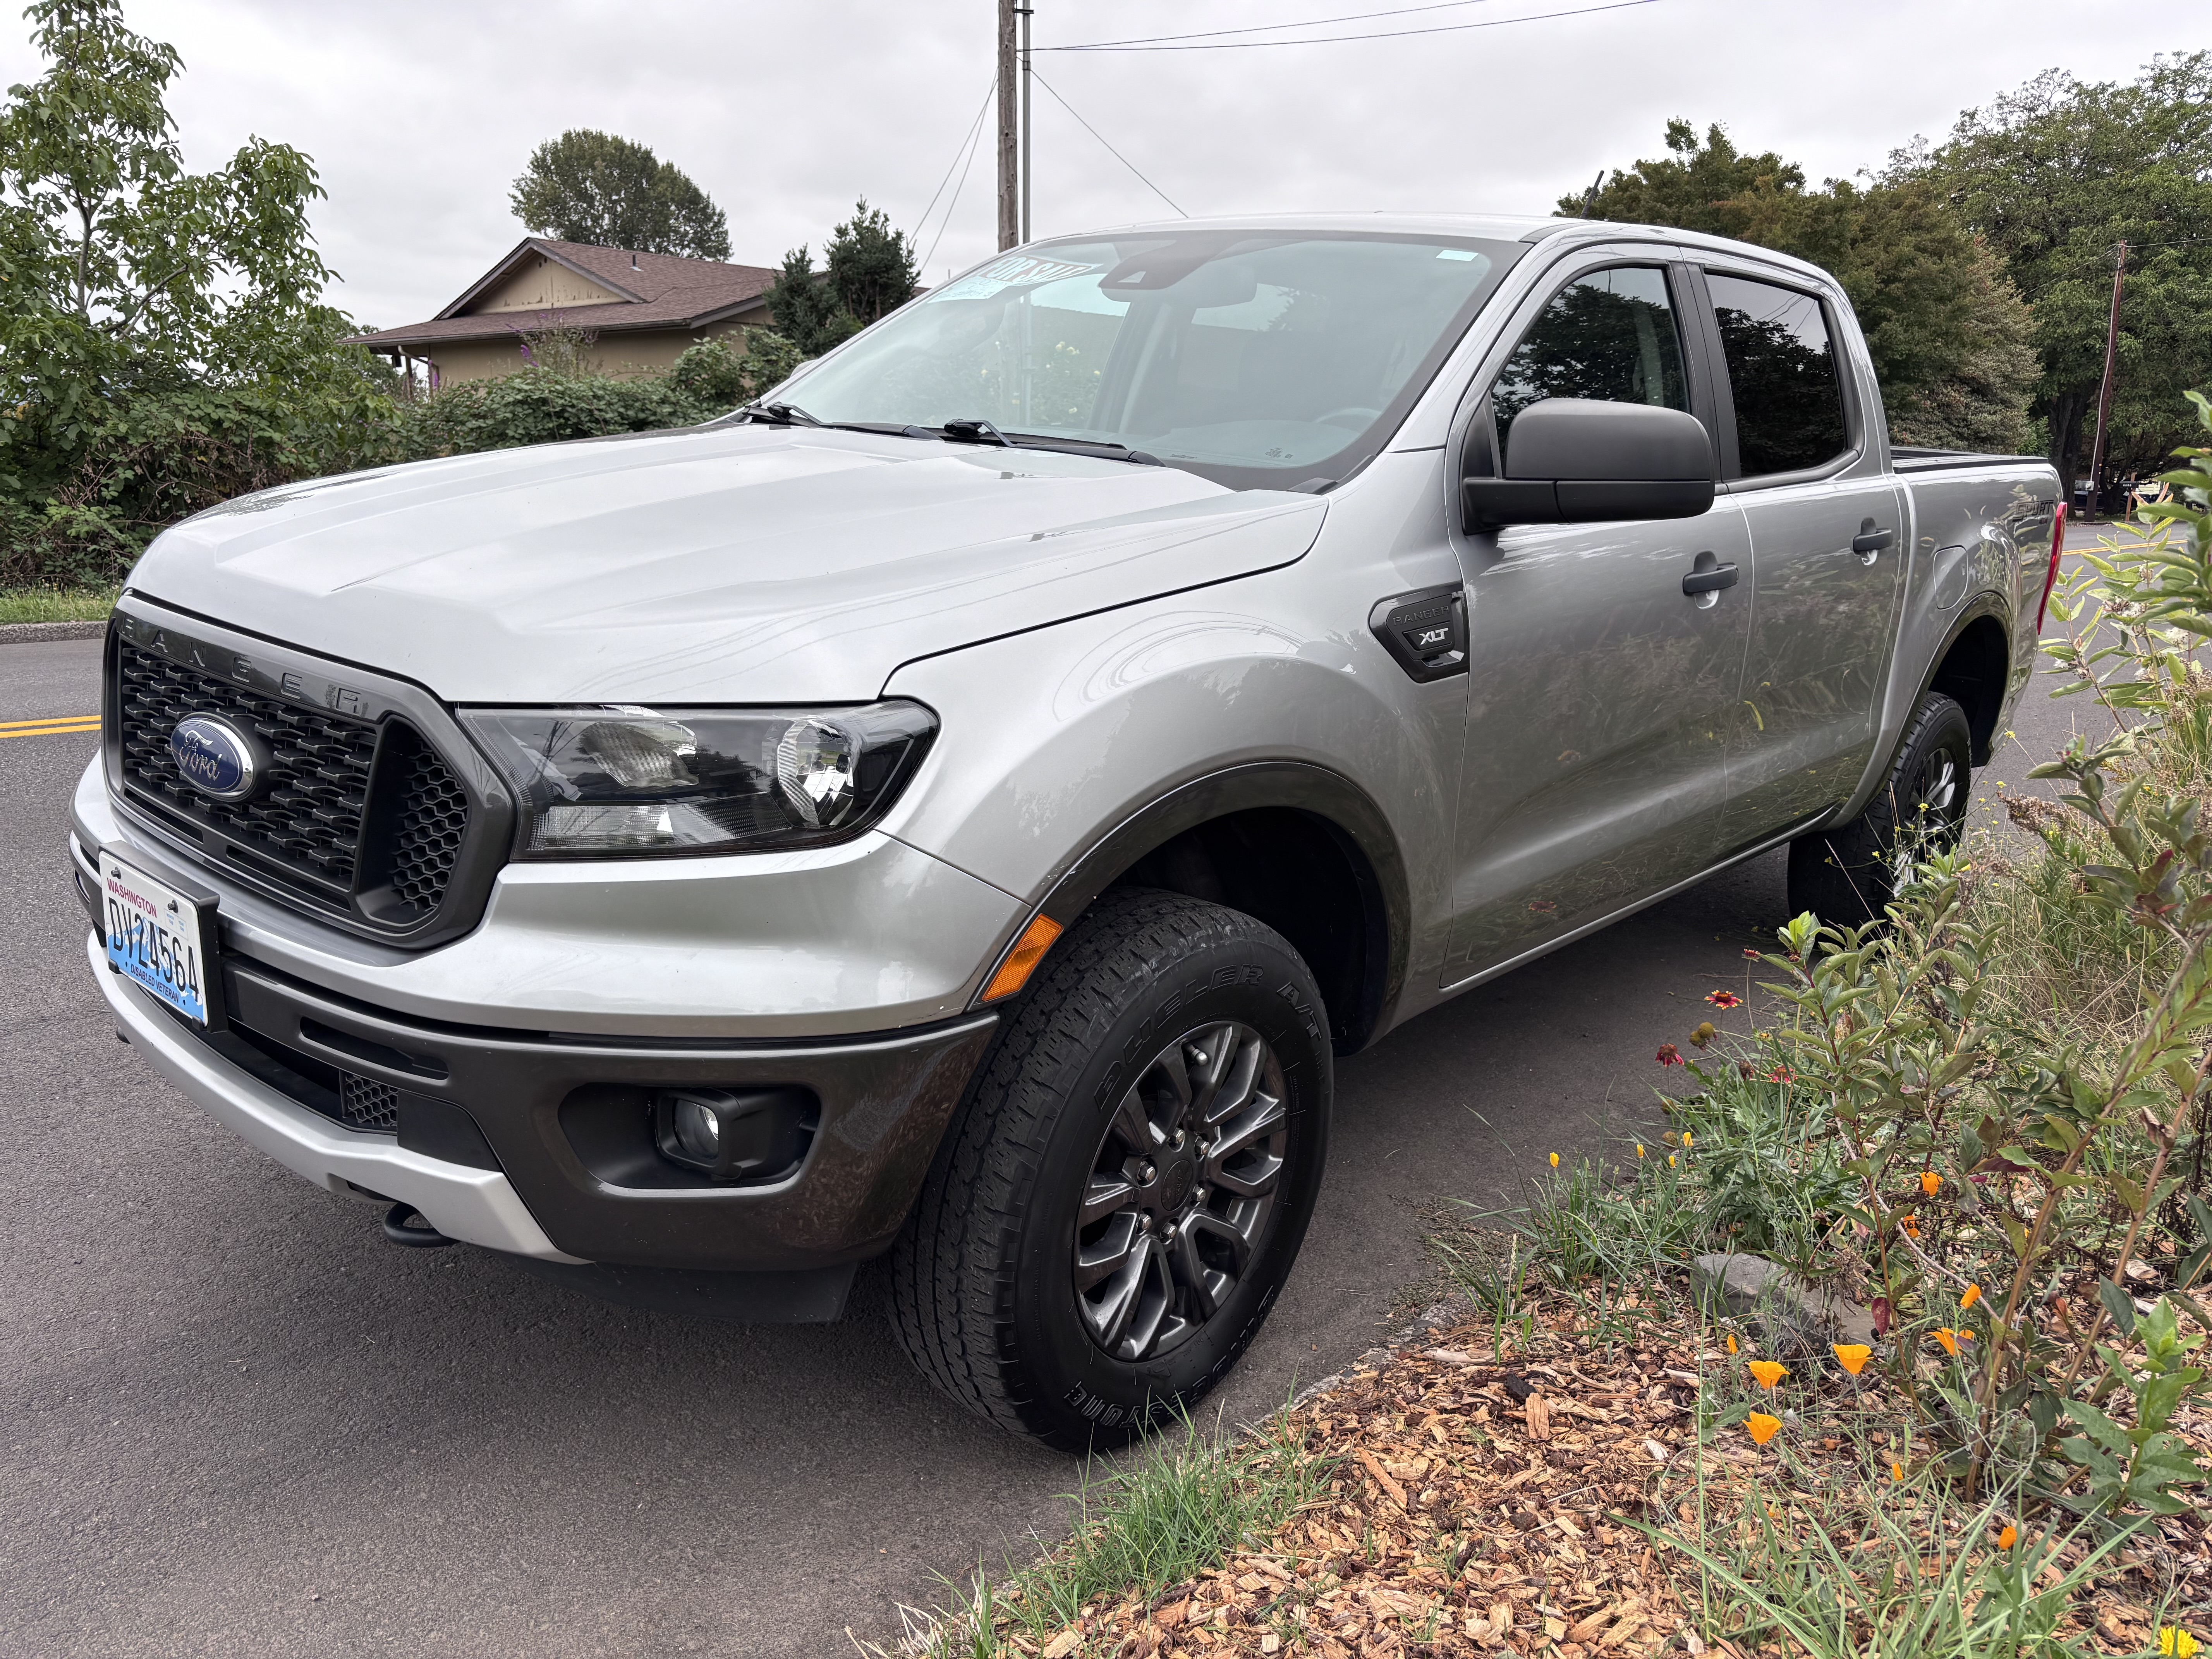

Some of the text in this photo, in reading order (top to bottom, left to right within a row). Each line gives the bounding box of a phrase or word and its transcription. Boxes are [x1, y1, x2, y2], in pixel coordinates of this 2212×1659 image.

[1012, 263, 1092, 282] SALE
[2012, 500, 2054, 522] SPORT
[1393, 606, 1450, 626] RANGER
[1419, 627, 1449, 645] XLT
[121, 615, 363, 716] RANGER
[179, 730, 223, 781] Ford
[106, 877, 157, 918] WASHINGTON
[108, 896, 199, 1003] DV24564
[131, 963, 179, 1004] DISABLED VETERAN
[1094, 963, 1323, 1113] DUELER A/T
